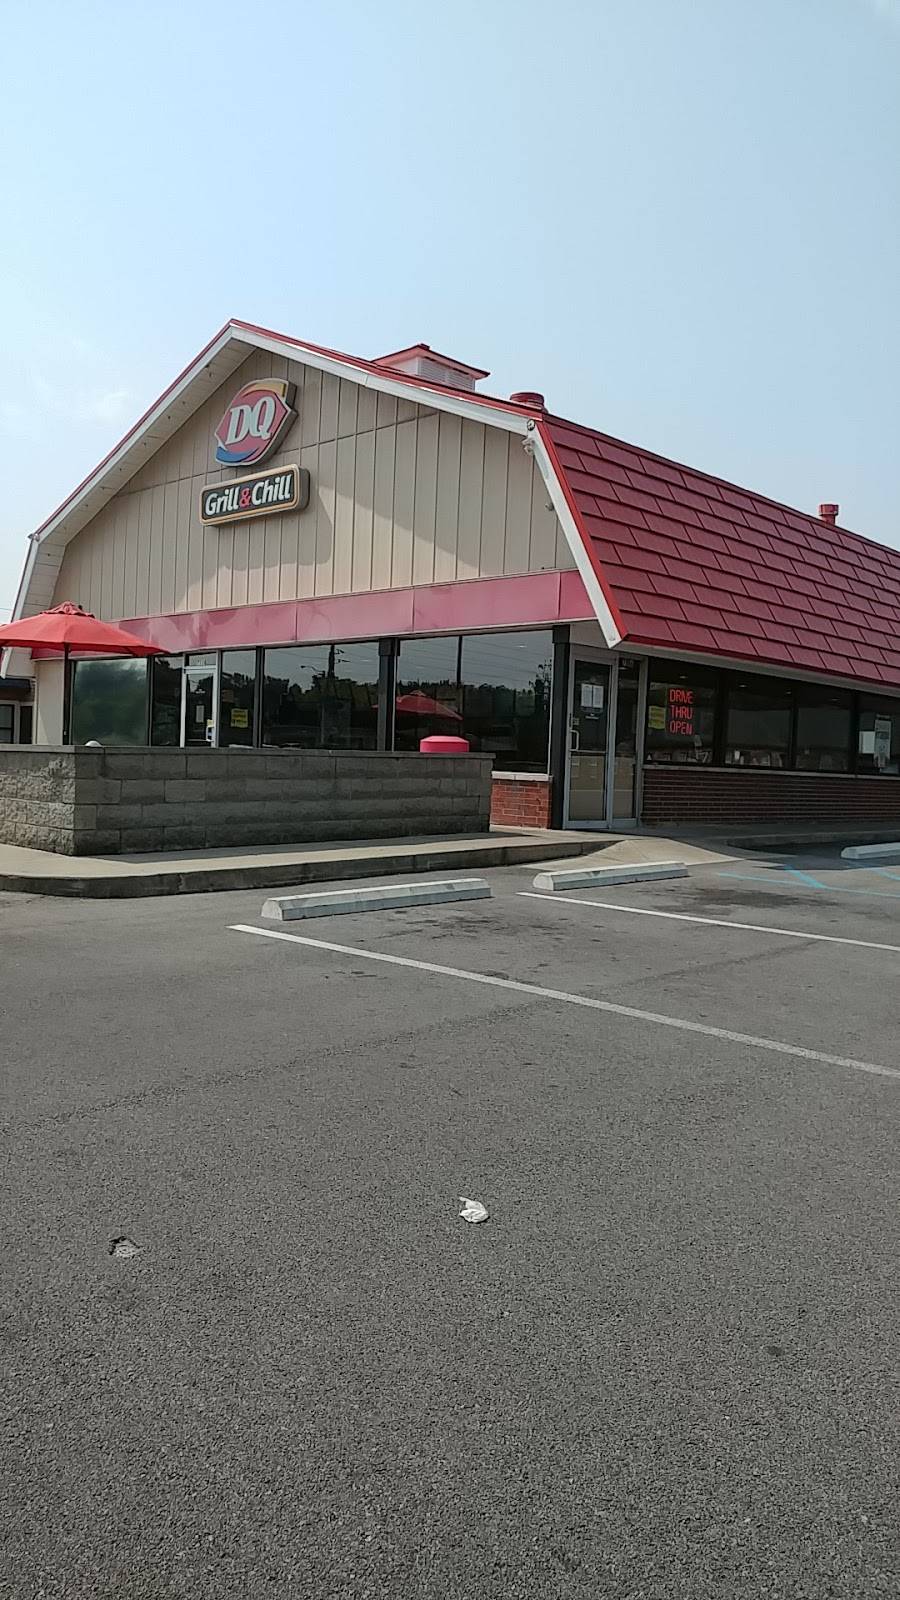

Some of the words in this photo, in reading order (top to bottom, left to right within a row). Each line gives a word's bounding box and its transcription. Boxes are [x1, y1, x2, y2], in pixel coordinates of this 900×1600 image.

[225, 396, 275, 445] DQ
[669, 688, 694, 704] DRIVE
[671, 704, 693, 720] THRU
[670, 720, 693, 735] OPEN
